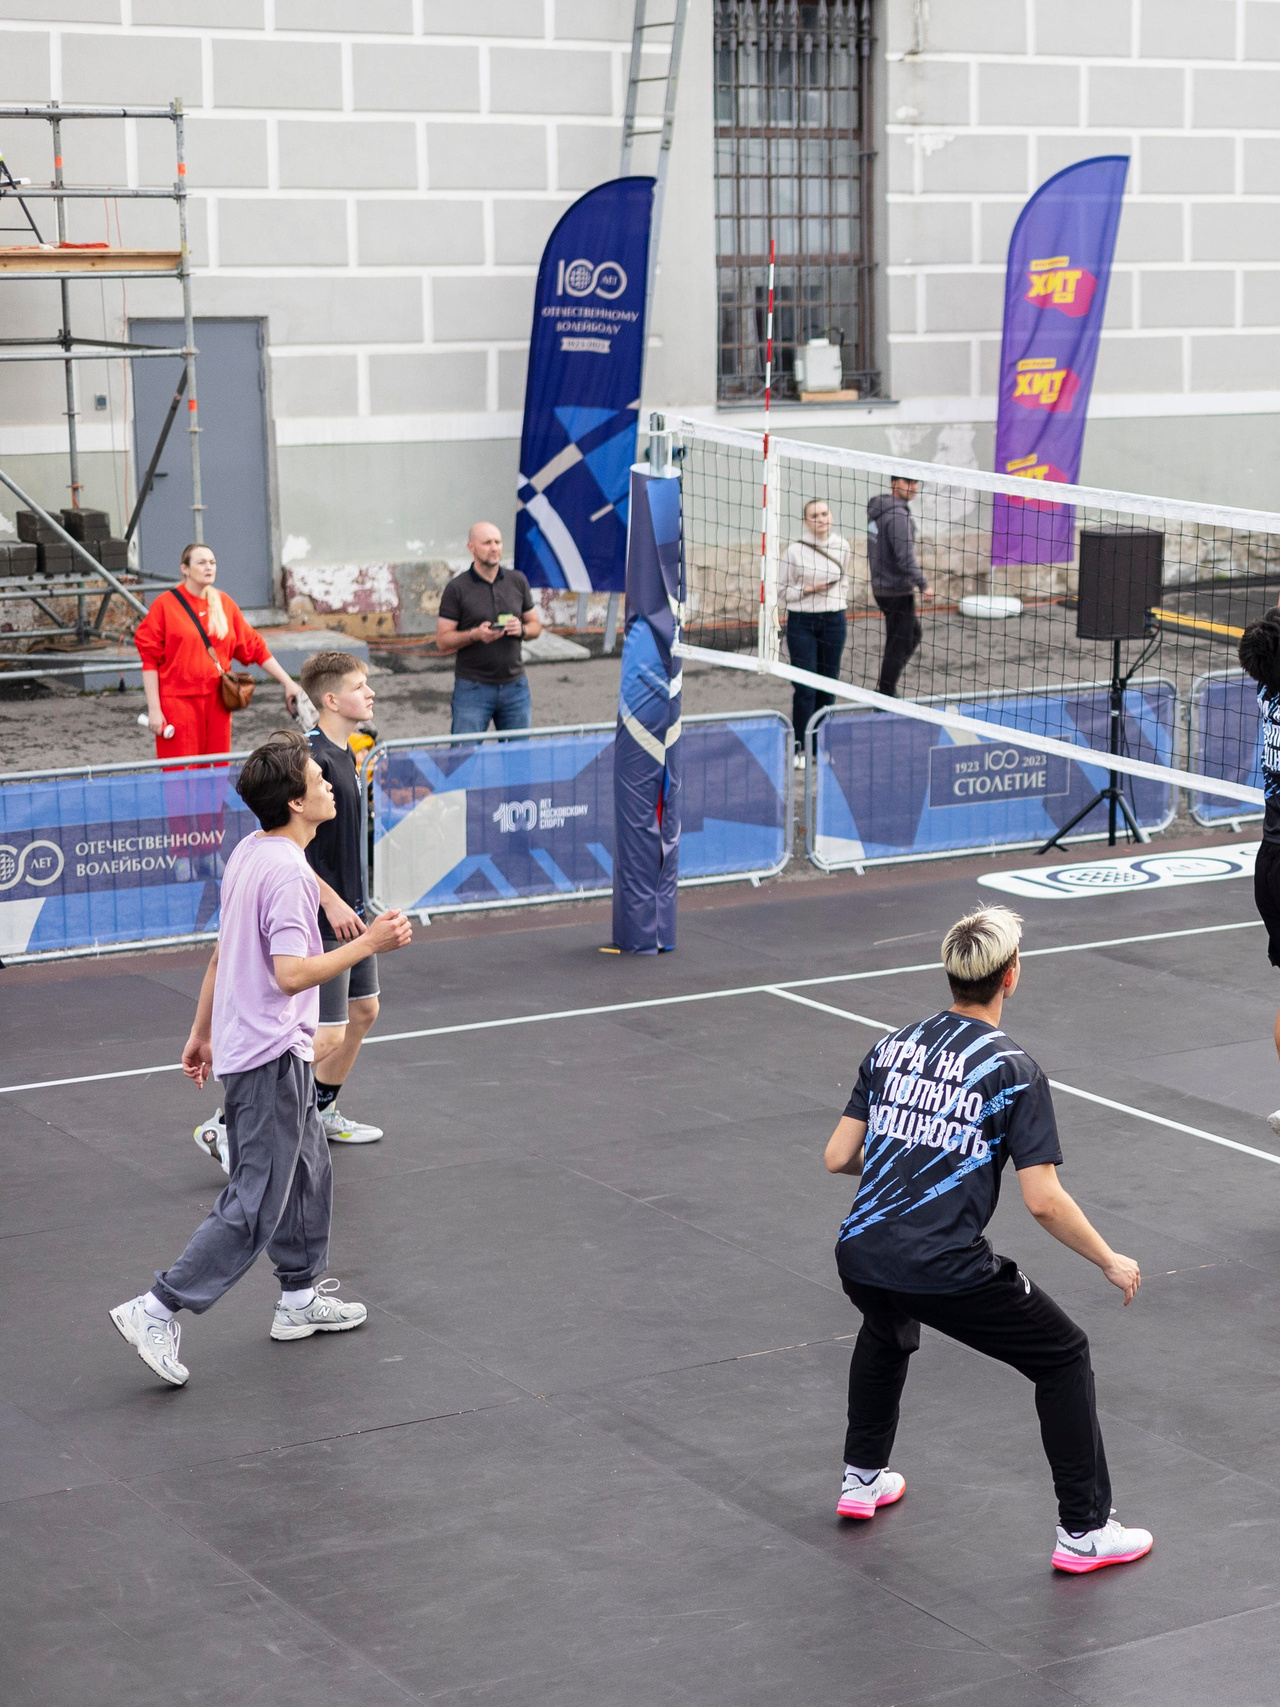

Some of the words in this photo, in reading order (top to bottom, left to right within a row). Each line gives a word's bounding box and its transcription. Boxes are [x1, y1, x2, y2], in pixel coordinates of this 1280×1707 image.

[541, 306, 639, 323] ОТЕЧЕСТВЕННОМУ
[556, 320, 621, 336] ВОЛЕЙБОЛУ
[955, 761, 980, 774] 1923
[1023, 754, 1047, 767] 2023
[953, 771, 1047, 796] СТОЛЕТИЕ
[493, 799, 538, 833] 100
[540, 804, 589, 820] МОСКОВСКОМУ
[540, 817, 566, 831] СПОРТУ
[75, 829, 226, 856] ОТЕЧЕСТВЕННОМУ
[31, 857, 52, 869] ЛЕТ
[76, 855, 177, 877] ВОЛЕЙБОЛУ
[875, 1040, 928, 1075] ИГРА
[934, 1049, 967, 1082] НА
[882, 1071, 983, 1122] ПОЛНУЮ
[869, 1104, 989, 1160] МОЩНОСТЬ
